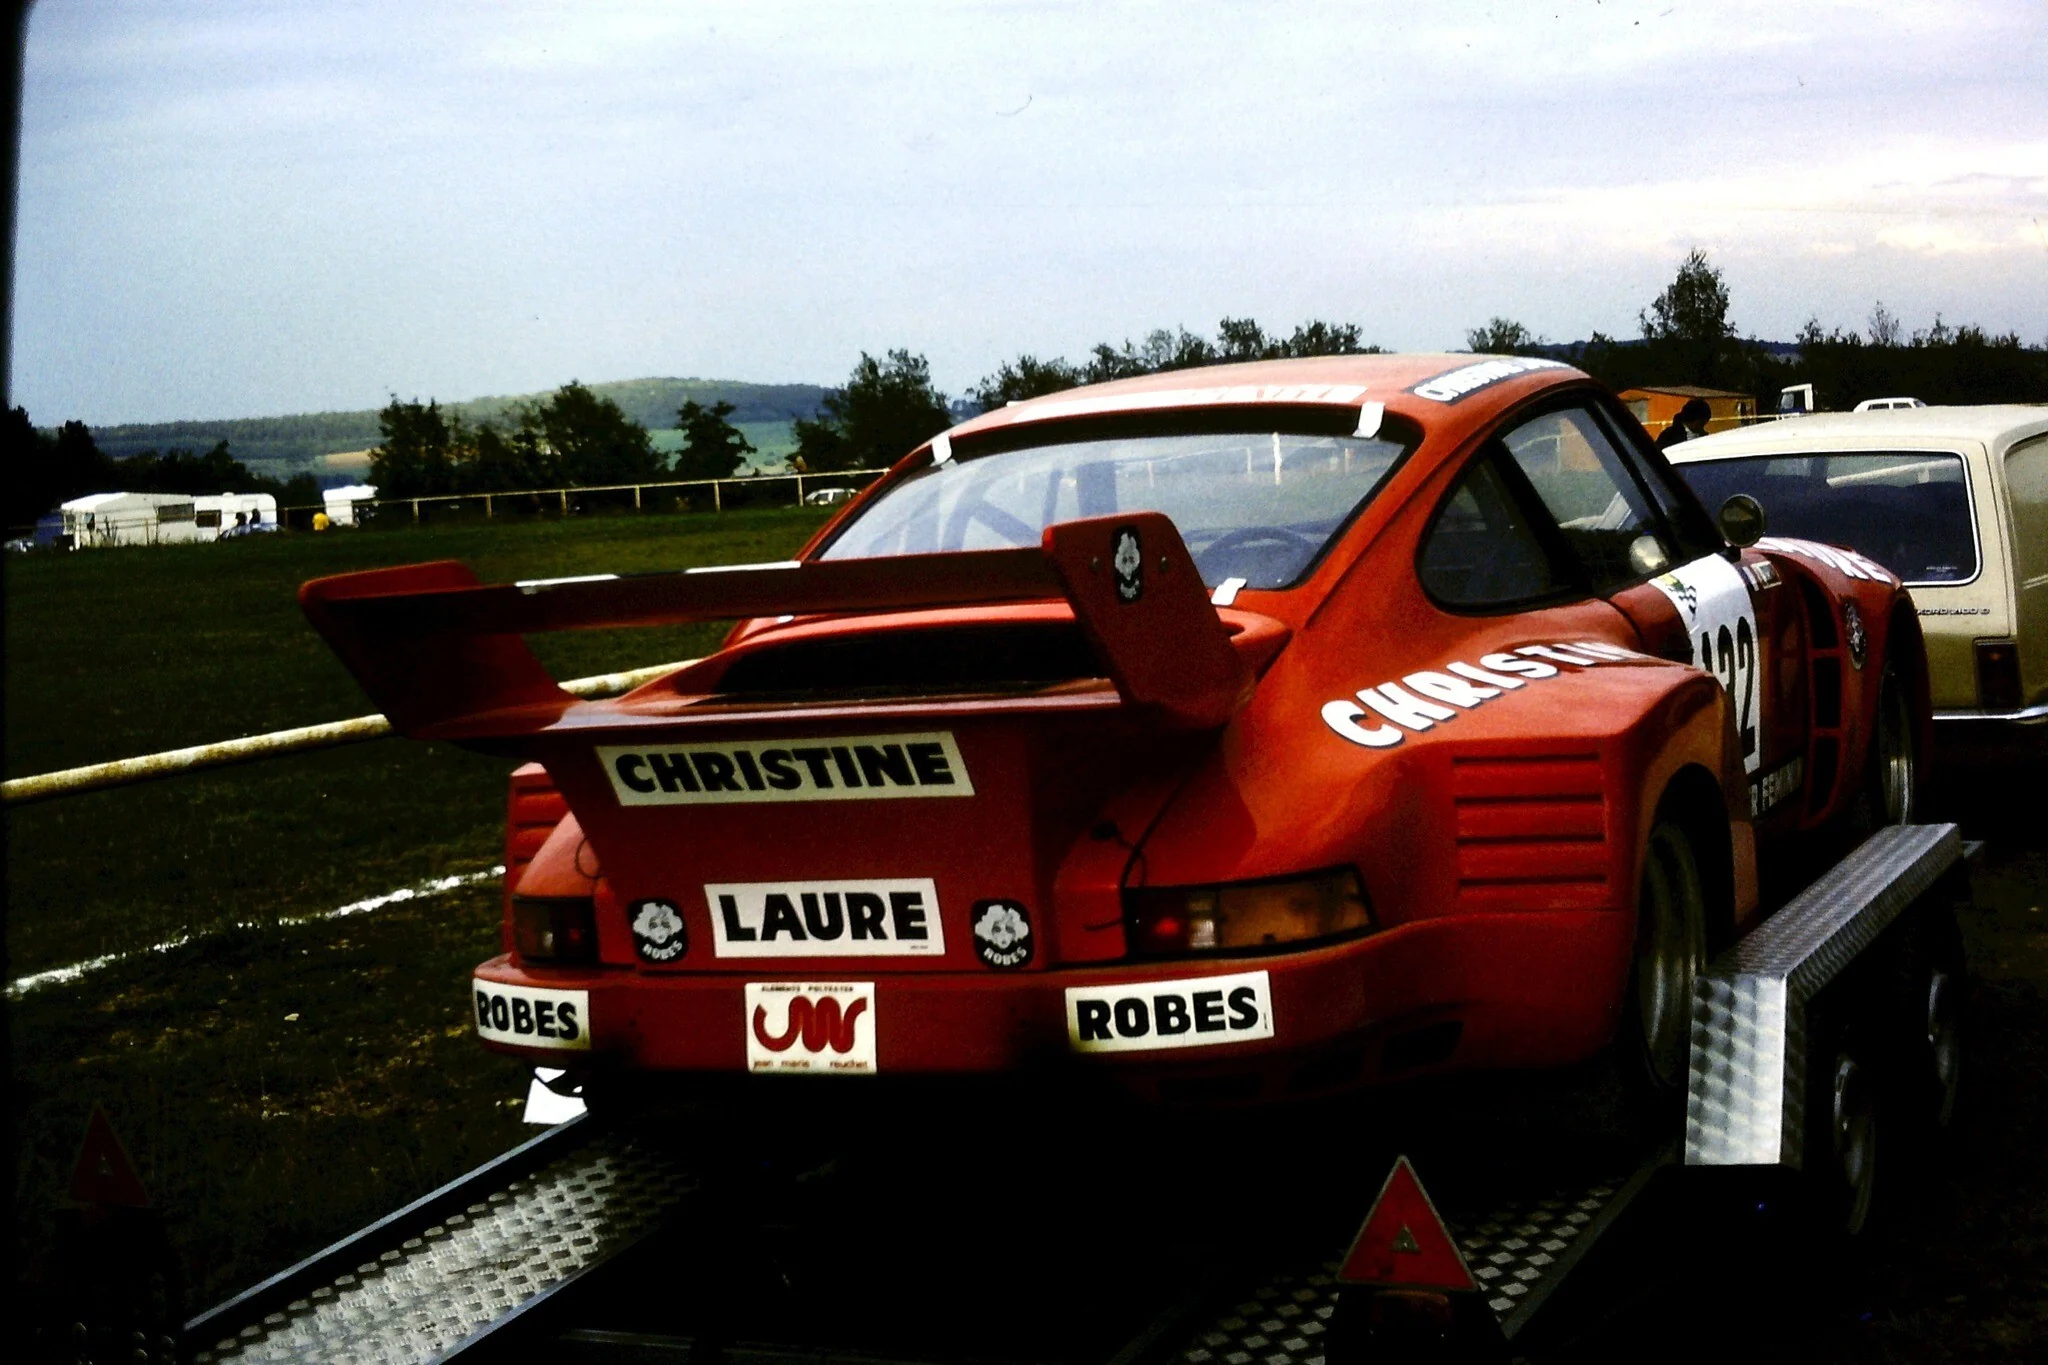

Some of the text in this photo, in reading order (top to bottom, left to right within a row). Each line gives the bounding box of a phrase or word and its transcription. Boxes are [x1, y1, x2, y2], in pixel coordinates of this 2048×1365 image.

[1320, 641, 1645, 750] CHRISTIN
[614, 741, 956, 795] CHRISTINE
[717, 890, 930, 943] LAURE
[983, 946, 1027, 966] ROBES
[475, 989, 580, 1042] ROBES
[1076, 986, 1260, 1041] ROBES
